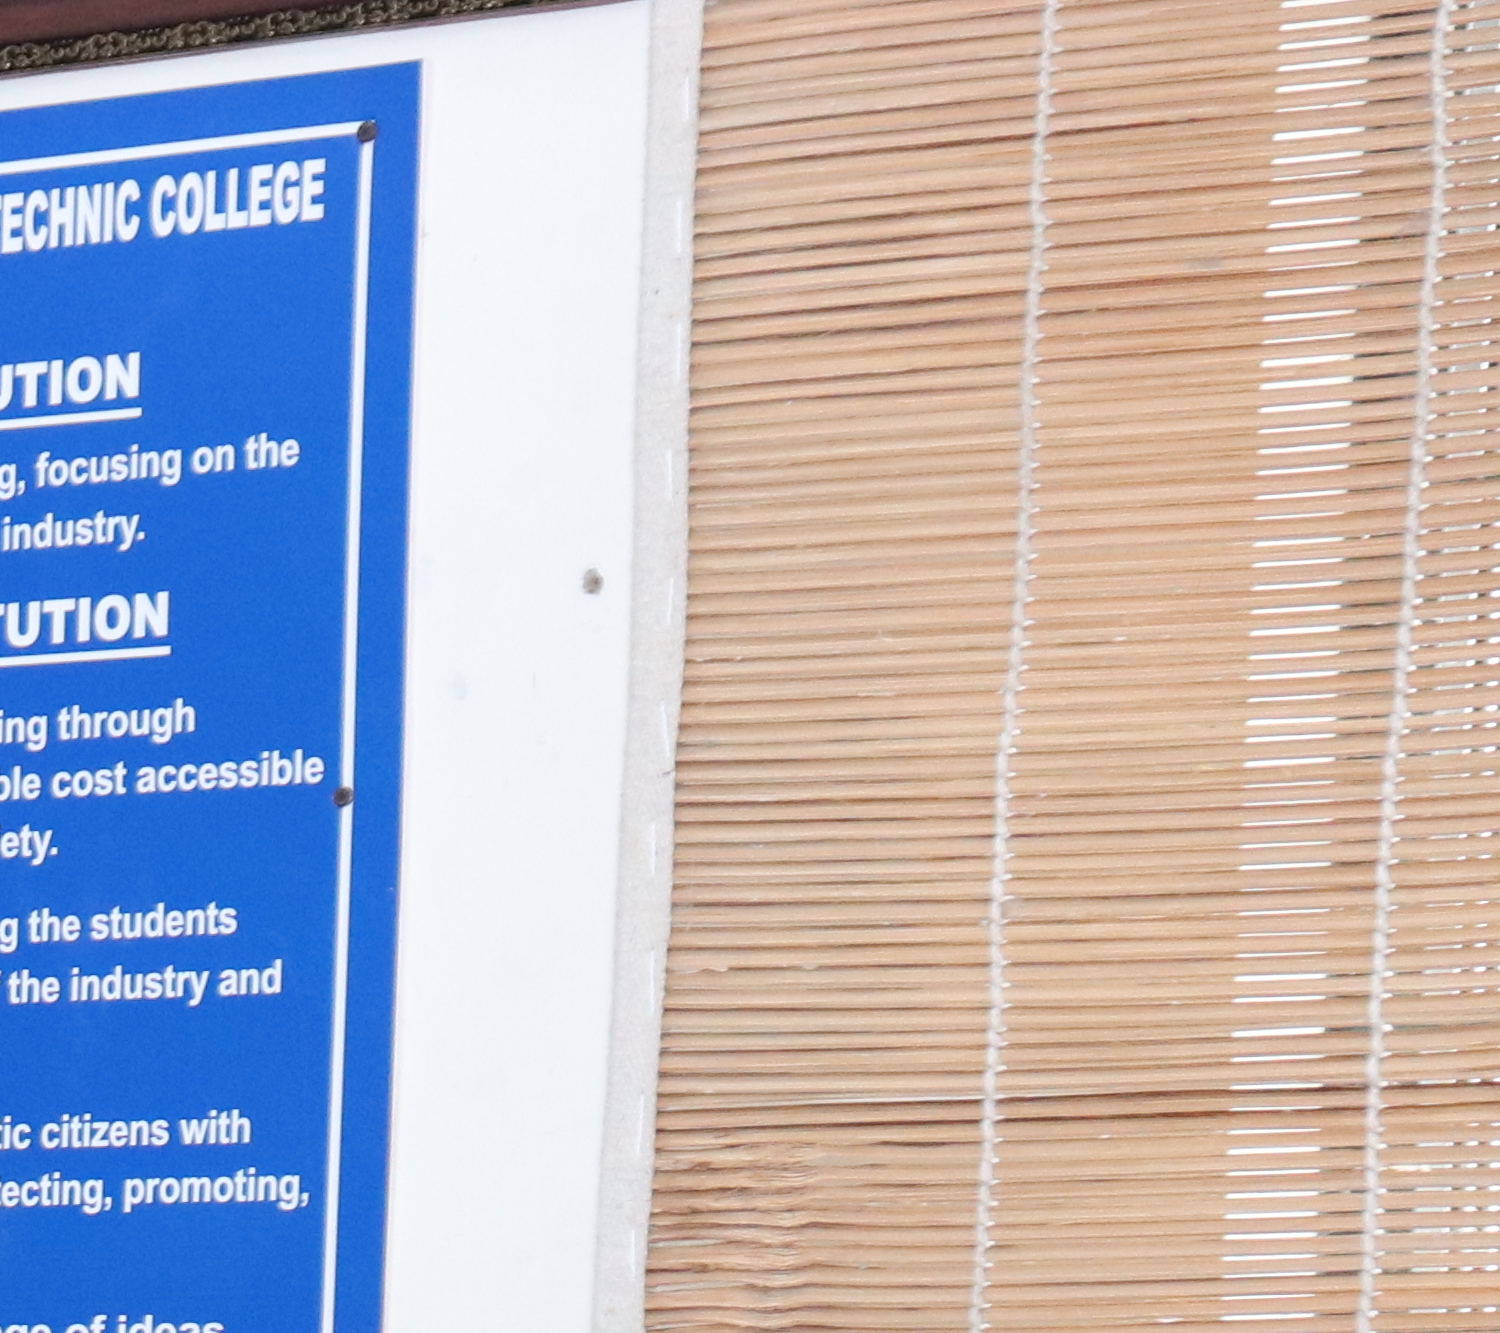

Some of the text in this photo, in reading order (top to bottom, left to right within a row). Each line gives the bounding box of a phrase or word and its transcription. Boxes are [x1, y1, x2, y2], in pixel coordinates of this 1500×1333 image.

[148, 156, 326, 239] COLLEGE
[33, 442, 182, 488] focusing
[190, 443, 235, 475] on
[242, 431, 300, 471] the
[1, 509, 145, 552] industry.
[55, 696, 196, 745] through
